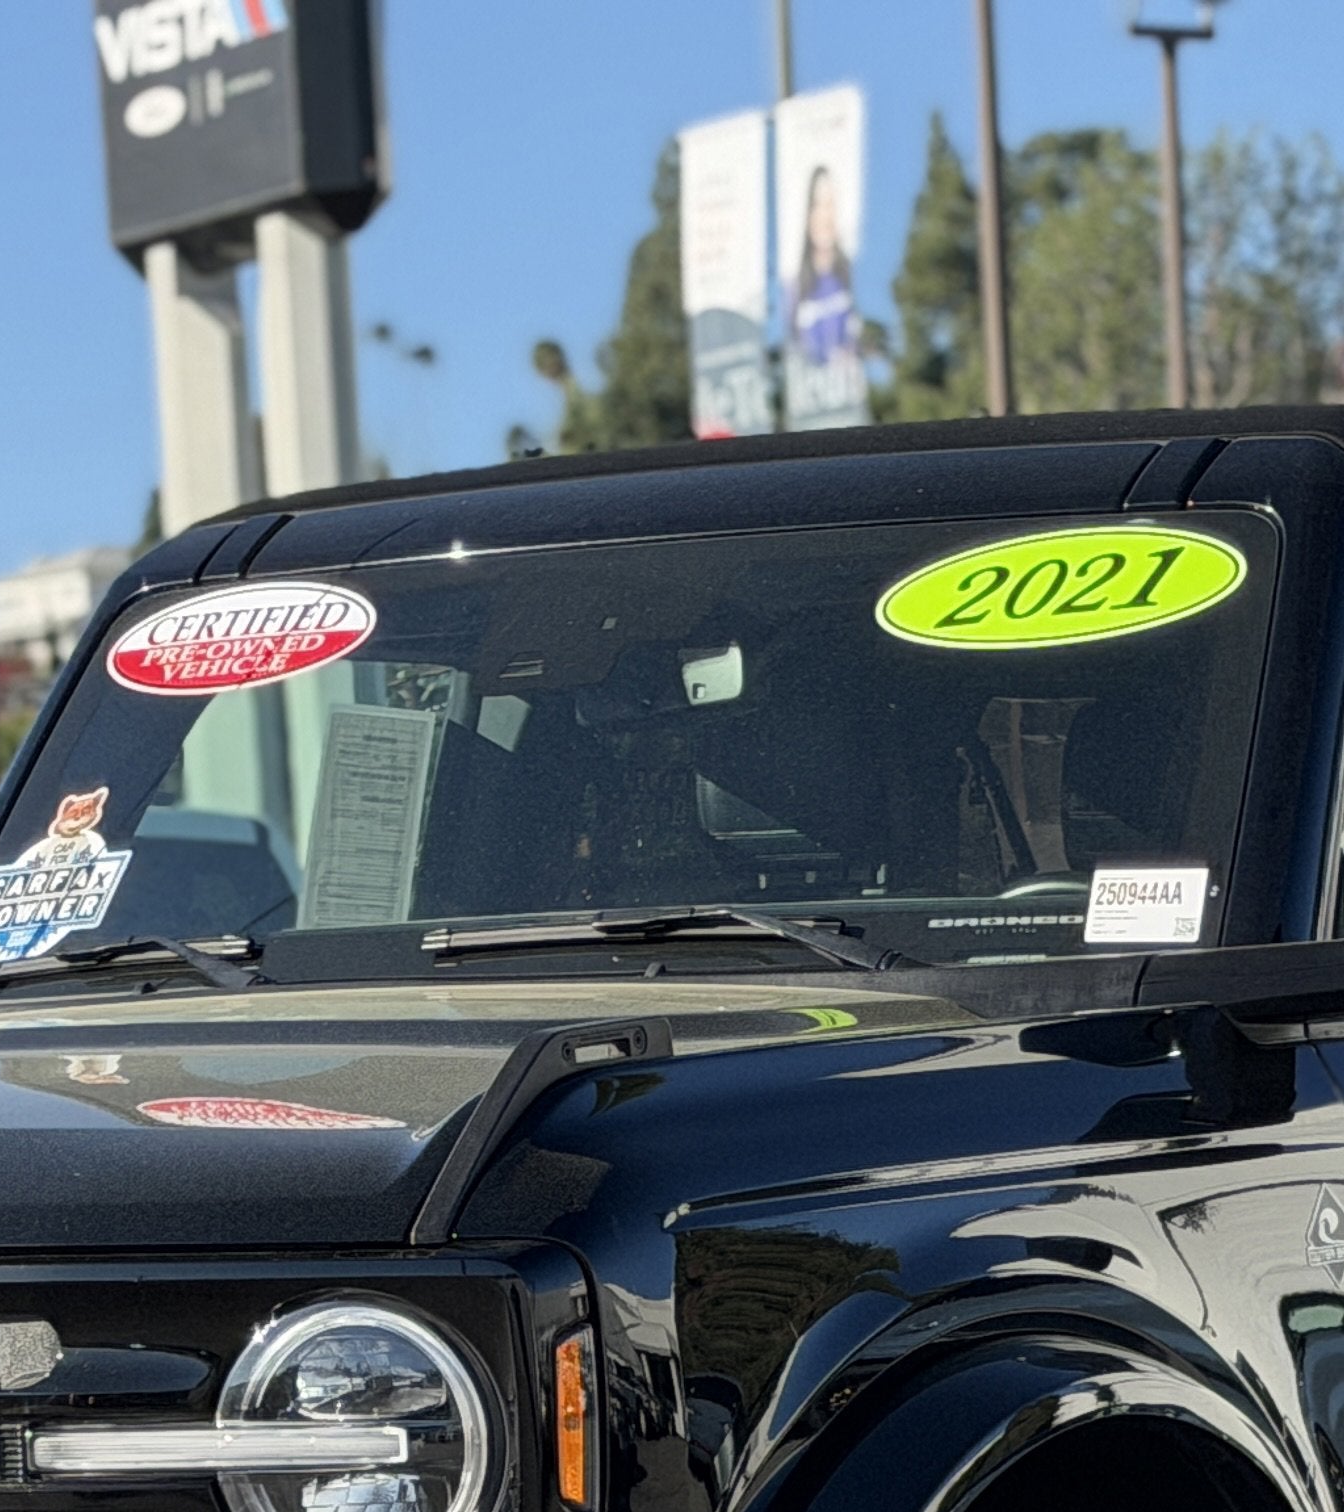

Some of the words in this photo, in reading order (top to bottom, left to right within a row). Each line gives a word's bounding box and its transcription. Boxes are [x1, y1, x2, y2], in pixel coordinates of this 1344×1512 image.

[94, 0, 240, 84] VISTA
[933, 546, 1185, 629] 2021
[148, 602, 350, 646] CERTIFIED
[140, 634, 326, 667] PRE-OWNED
[162, 653, 288, 681] VEHICLE
[1095, 881, 1182, 905] 250944AA
